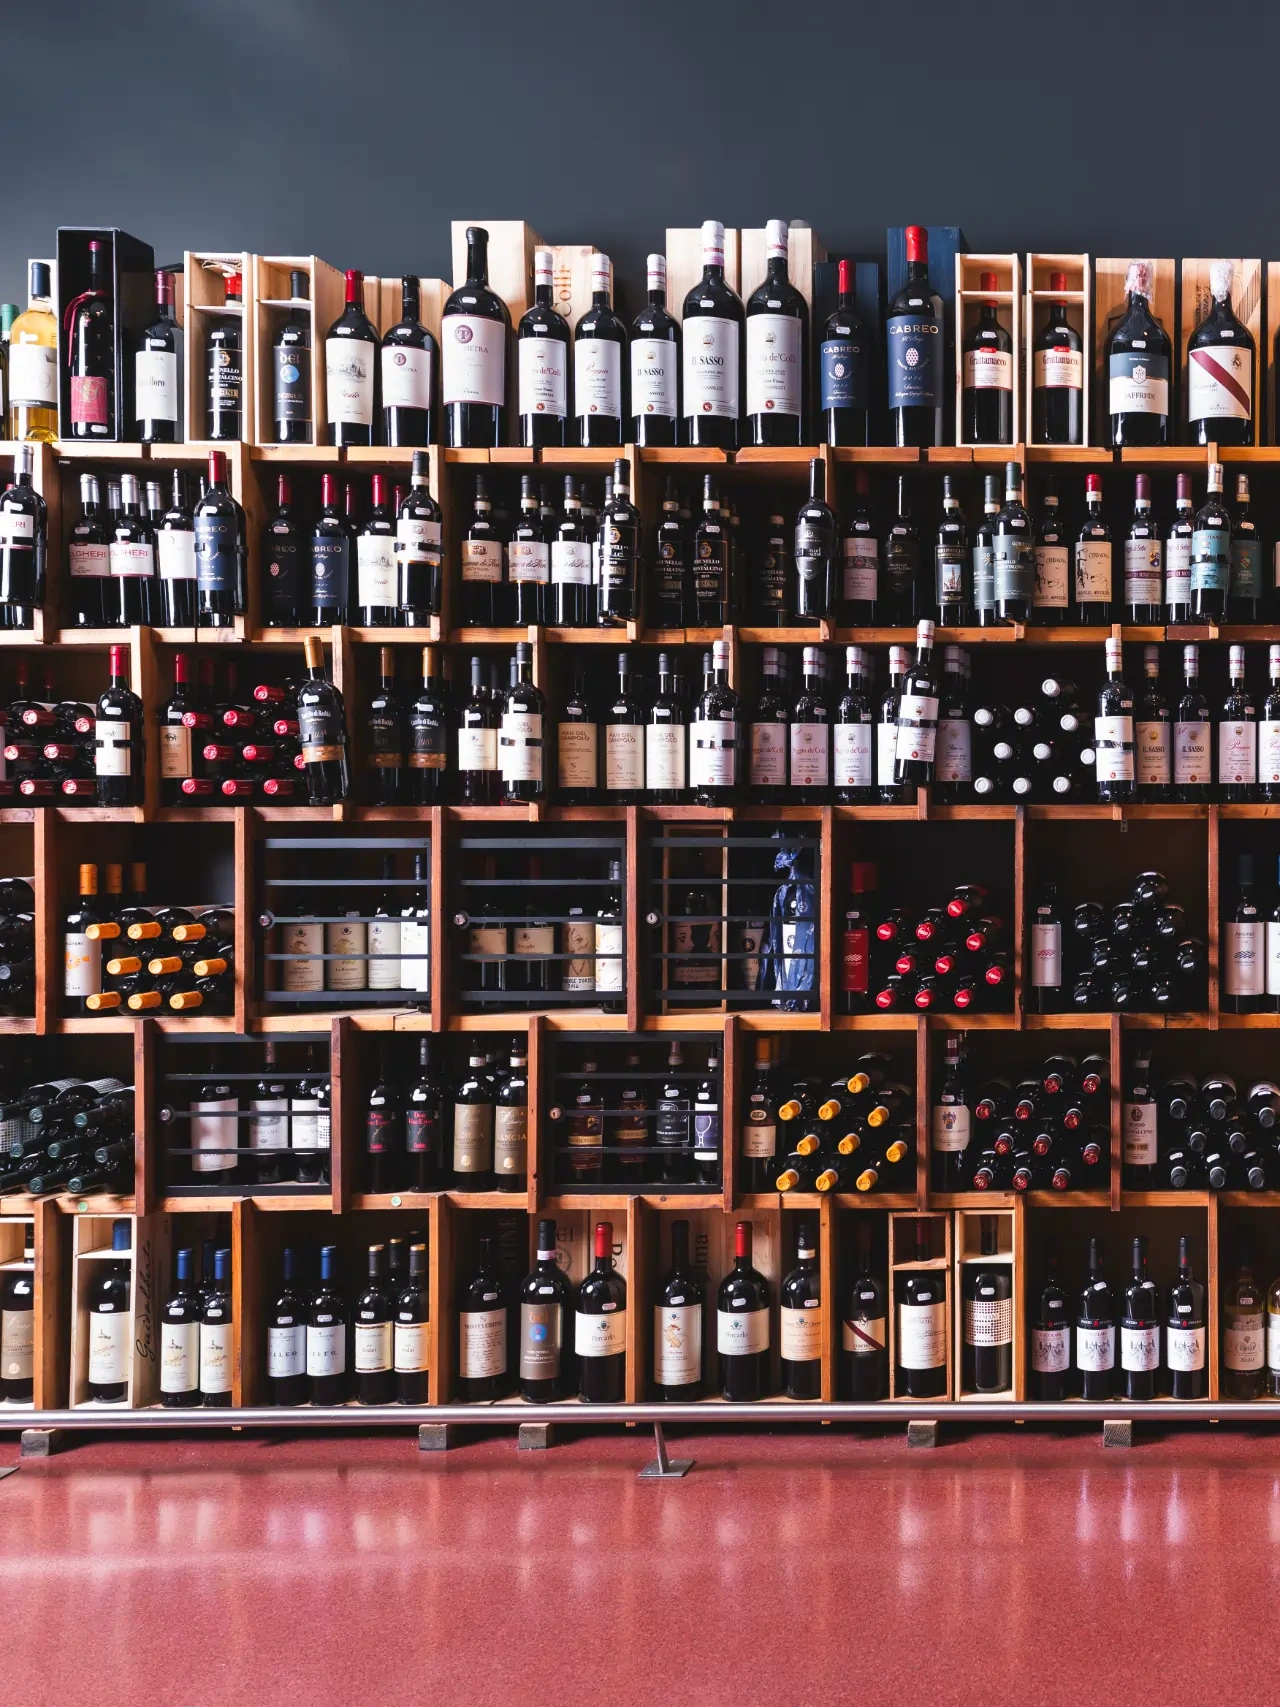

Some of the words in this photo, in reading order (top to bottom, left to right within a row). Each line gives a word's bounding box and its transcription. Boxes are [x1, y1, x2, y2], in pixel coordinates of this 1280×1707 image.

[889, 324, 939, 335] CABREO
[823, 346, 860, 355] CABREO
[699, 355, 724, 367] SASSO
[644, 367, 664, 377] SASSO
[1148, 745, 1166, 753] SASSO
